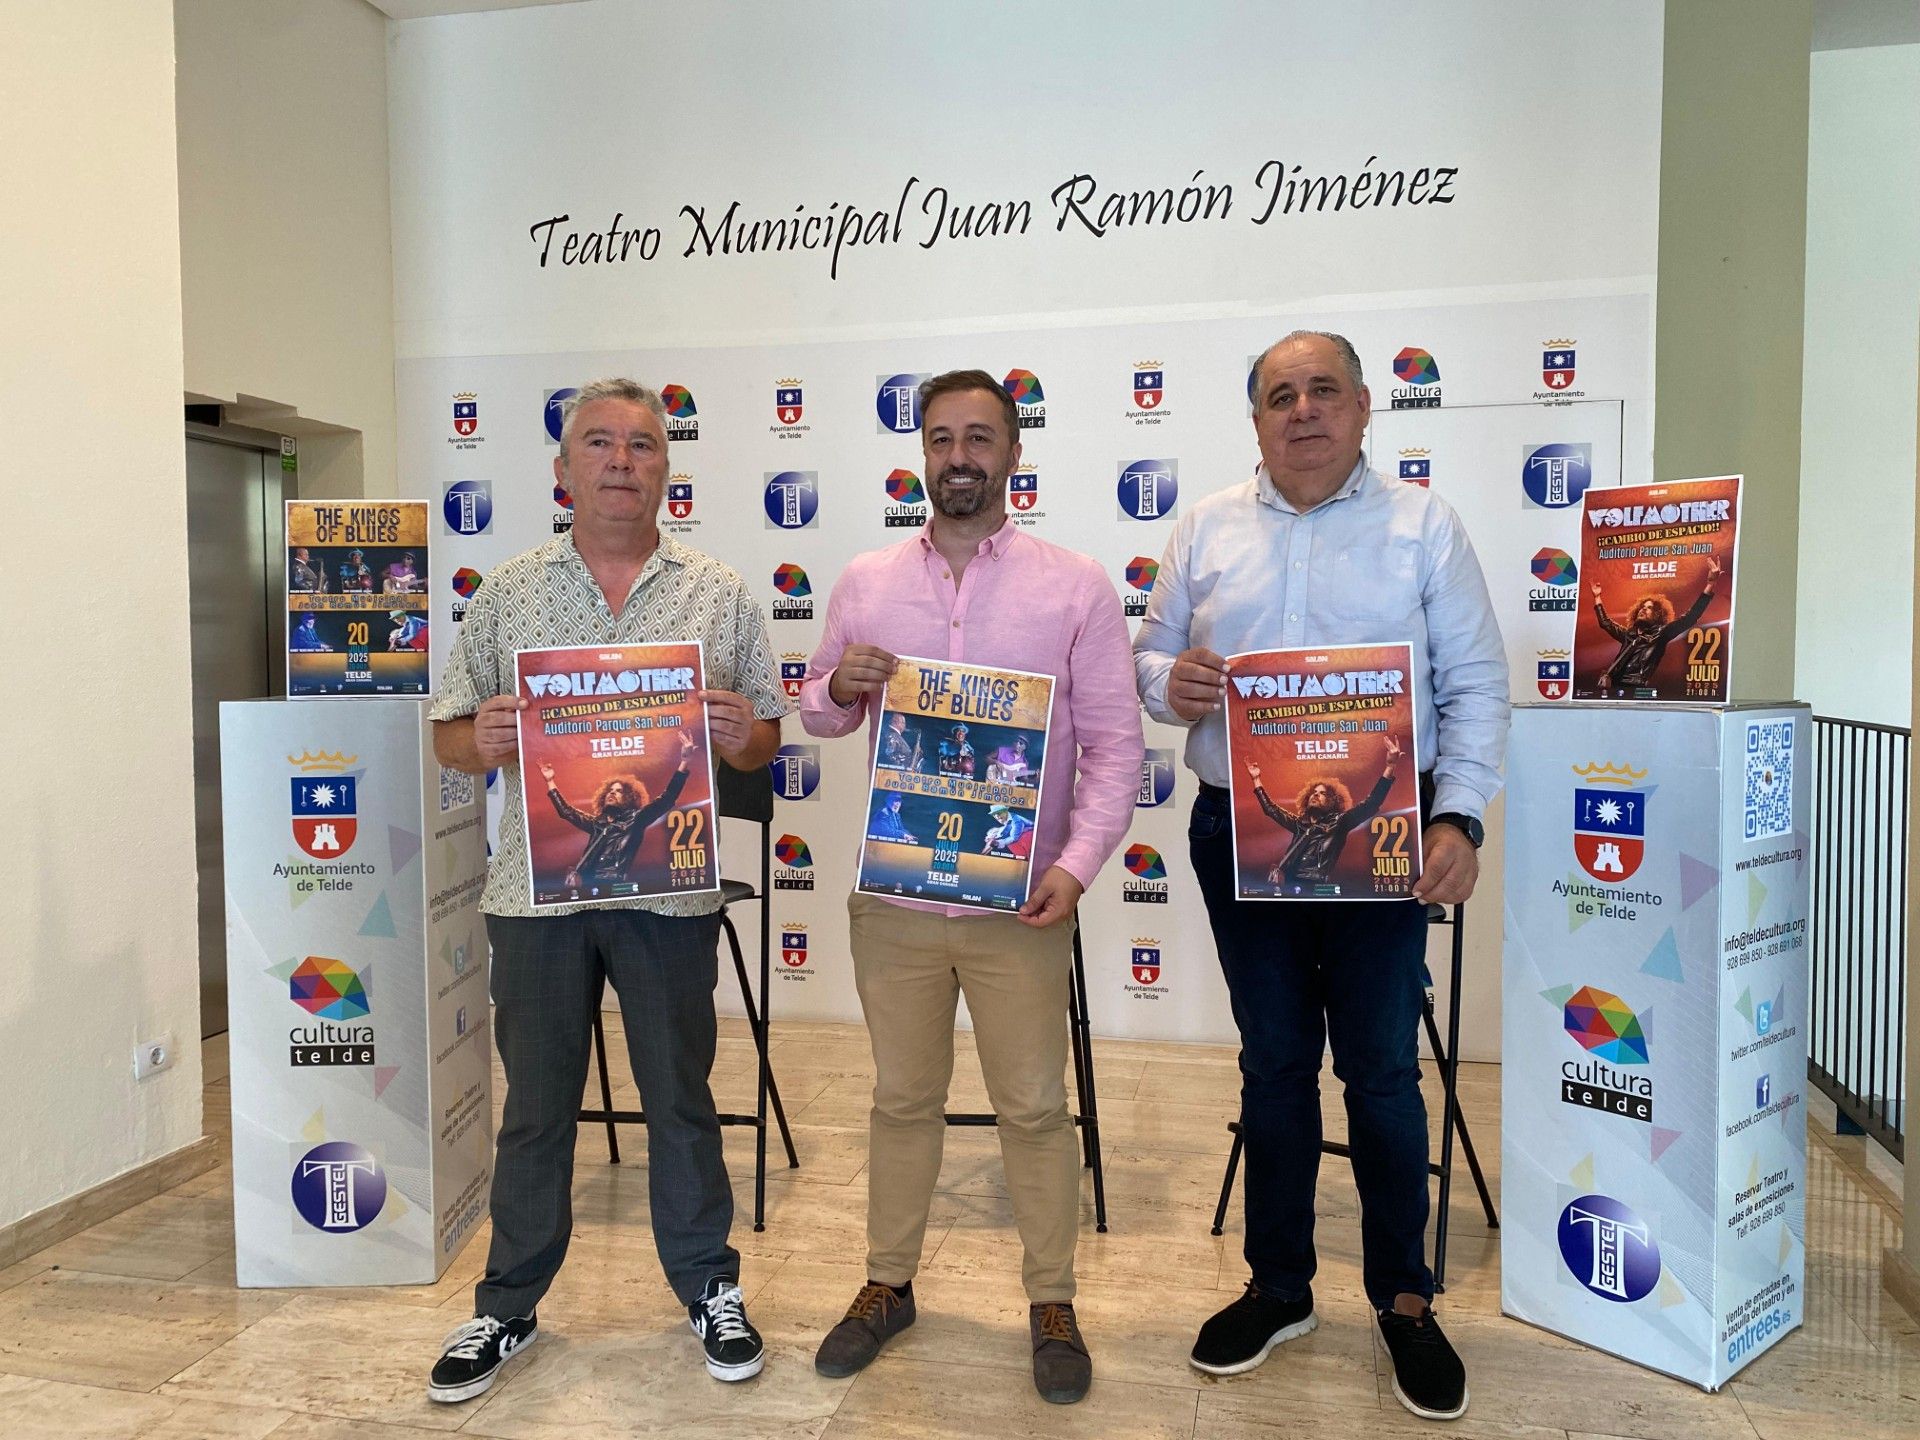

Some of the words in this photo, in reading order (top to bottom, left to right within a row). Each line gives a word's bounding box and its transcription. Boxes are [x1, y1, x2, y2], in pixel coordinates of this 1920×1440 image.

[530, 213, 661, 268] Teatro
[679, 176, 920, 281] Municipal
[919, 187, 1031, 249] Juan
[1051, 173, 1233, 238] Ramón
[1252, 155, 1458, 224] Jiménez
[1391, 385, 1442, 399] cultura
[1533, 391, 1585, 399] Ayuntamiento
[900, 388, 910, 427] GESTEL
[1017, 405, 1046, 416] ltura
[1394, 400, 1440, 409] telde
[1125, 410, 1171, 418] Ayuntamiento
[665, 418, 699, 430] ultura
[668, 431, 697, 440] elde
[1551, 459, 1563, 501] GESTEL
[1143, 474, 1152, 513] GESTEL
[787, 485, 796, 523] GESTEL
[885, 504, 927, 516] cultura
[314, 508, 343, 526] THE
[351, 508, 400, 526] KINGS
[553, 512, 574, 523] cult
[887, 517, 925, 525] telde
[1588, 499, 1730, 529] WOLFMOTHER
[316, 526, 338, 543] OF
[345, 526, 399, 543] BLUES
[1649, 530, 1664, 540] DE
[1666, 524, 1720, 538] ESPACIO!!
[1599, 547, 1636, 559] Auditorio
[1640, 546, 1668, 559] Parque
[1672, 545, 1687, 555] San
[1691, 543, 1712, 554] Juan
[1632, 561, 1677, 573] TELDE
[772, 597, 813, 609] cultura
[1124, 592, 1148, 605] cult
[775, 610, 811, 618] telde
[348, 622, 369, 645] 20
[1687, 627, 1721, 665] 22
[349, 653, 368, 662] 2025
[345, 671, 372, 679] TELDE
[1686, 664, 1720, 682] JULIO
[524, 666, 696, 699] WOLFMOTHER
[918, 668, 952, 692] THE
[959, 673, 1020, 701] KINGS
[1231, 669, 1404, 700] WOLFMOTHER
[604, 699, 622, 711] DE
[624, 692, 685, 710] ESPACIO!!
[918, 690, 944, 711] OF
[950, 694, 1014, 722] BLUES
[1308, 702, 1326, 713] DE
[1328, 696, 1393, 712] ESPACIO!!
[544, 719, 592, 735] Auditorio
[596, 717, 631, 732] Parque
[634, 715, 653, 728] San
[656, 714, 682, 727] Juan
[1251, 722, 1297, 735] Auditorio
[1300, 721, 1336, 735] Parque
[1339, 720, 1358, 732] San
[1362, 719, 1388, 732] Juan
[590, 736, 645, 751] TELDE
[1295, 740, 1348, 753] TELDE
[789, 757, 798, 794] GESTEL
[667, 808, 705, 851] 22
[936, 811, 964, 842] 20
[1370, 816, 1409, 857] 22
[670, 850, 706, 870] JULIO
[934, 849, 957, 863] 2025
[1735, 848, 1802, 872] www.teldecultura.org
[273, 862, 375, 877] Ayuntamiento
[774, 868, 815, 880] cultura
[1372, 857, 1410, 876] JULIO
[296, 878, 314, 892] de
[317, 877, 353, 891] Telde
[776, 880, 812, 889] telde
[927, 871, 959, 884] TELDE
[1123, 879, 1168, 892] cultura
[1126, 892, 1166, 902] telde
[1552, 879, 1662, 906] Ayuntamiento
[1576, 900, 1594, 916] de
[1598, 902, 1636, 921] Telde
[1724, 918, 1806, 953] info@teldecultura.org
[1727, 956, 1739, 970] 928
[1751, 947, 1763, 962] 850
[1767, 942, 1779, 957] 928
[775, 967, 815, 976] Ayuntamiento
[1124, 984, 1169, 993] Ayuntamiento
[289, 1021, 374, 1045] cultura
[295, 1049, 370, 1064] telde
[1561, 1060, 1652, 1097] cultura
[1566, 1083, 1648, 1118] telde
[333, 1163, 346, 1223] GESTEL
[1735, 1182, 1763, 1206] Reservar
[1763, 1171, 1784, 1188] Teatro
[1728, 1210, 1745, 1228] salas
[1745, 1204, 1753, 1217] de
[1754, 1182, 1795, 1211] exposiciones
[1601, 1222, 1615, 1289] GESTEL
[1726, 1305, 1744, 1324] Venta
[1744, 1298, 1752, 1312] de
[1753, 1279, 1781, 1304] entradas
[1781, 1273, 1790, 1285] en
[1727, 1311, 1750, 1338] taquilla
[1750, 1302, 1761, 1320] del
[1762, 1292, 1781, 1312] teatro
[1786, 1282, 1795, 1295] en
